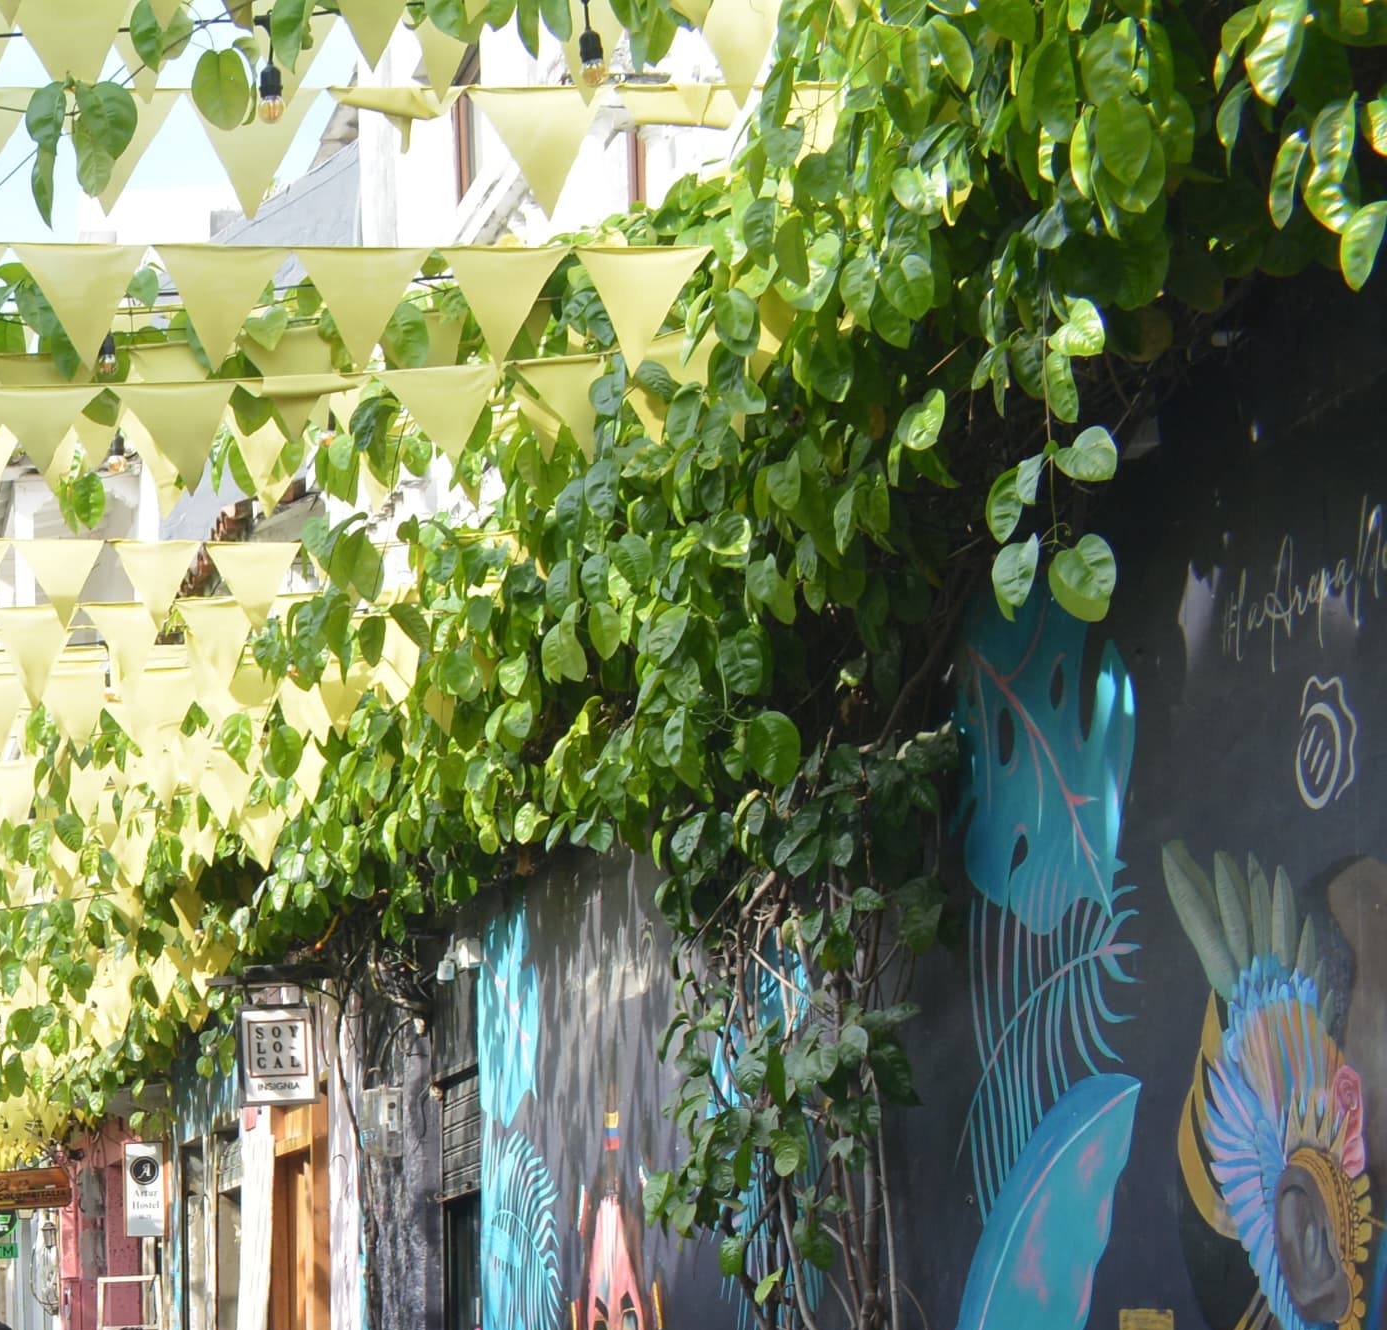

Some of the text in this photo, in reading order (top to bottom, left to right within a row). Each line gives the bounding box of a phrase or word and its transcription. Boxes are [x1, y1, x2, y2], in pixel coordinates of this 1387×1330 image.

[255, 1025, 299, 1040] SOY
[257, 1056, 301, 1069] CAL
[257, 1082, 300, 1091] INSIGNIA
[132, 1201, 160, 1210] Hostel
